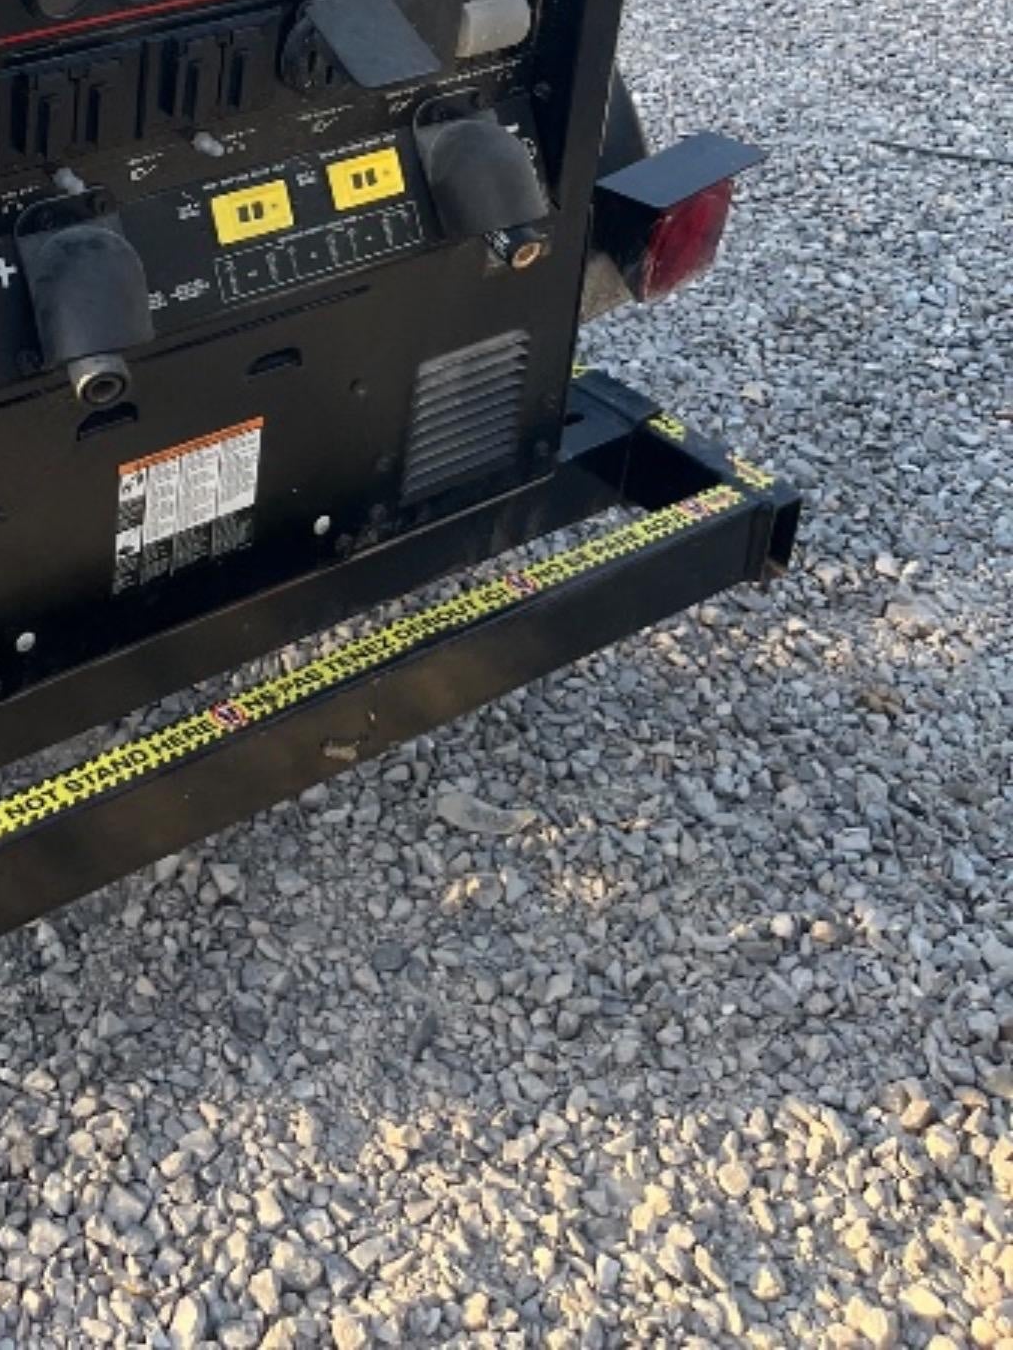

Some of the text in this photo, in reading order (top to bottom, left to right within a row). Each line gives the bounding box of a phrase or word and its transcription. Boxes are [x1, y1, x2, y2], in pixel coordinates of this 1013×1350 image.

[5, 789, 59, 819] NOT
[63, 749, 148, 793] STAND
[151, 721, 215, 756] HERE
